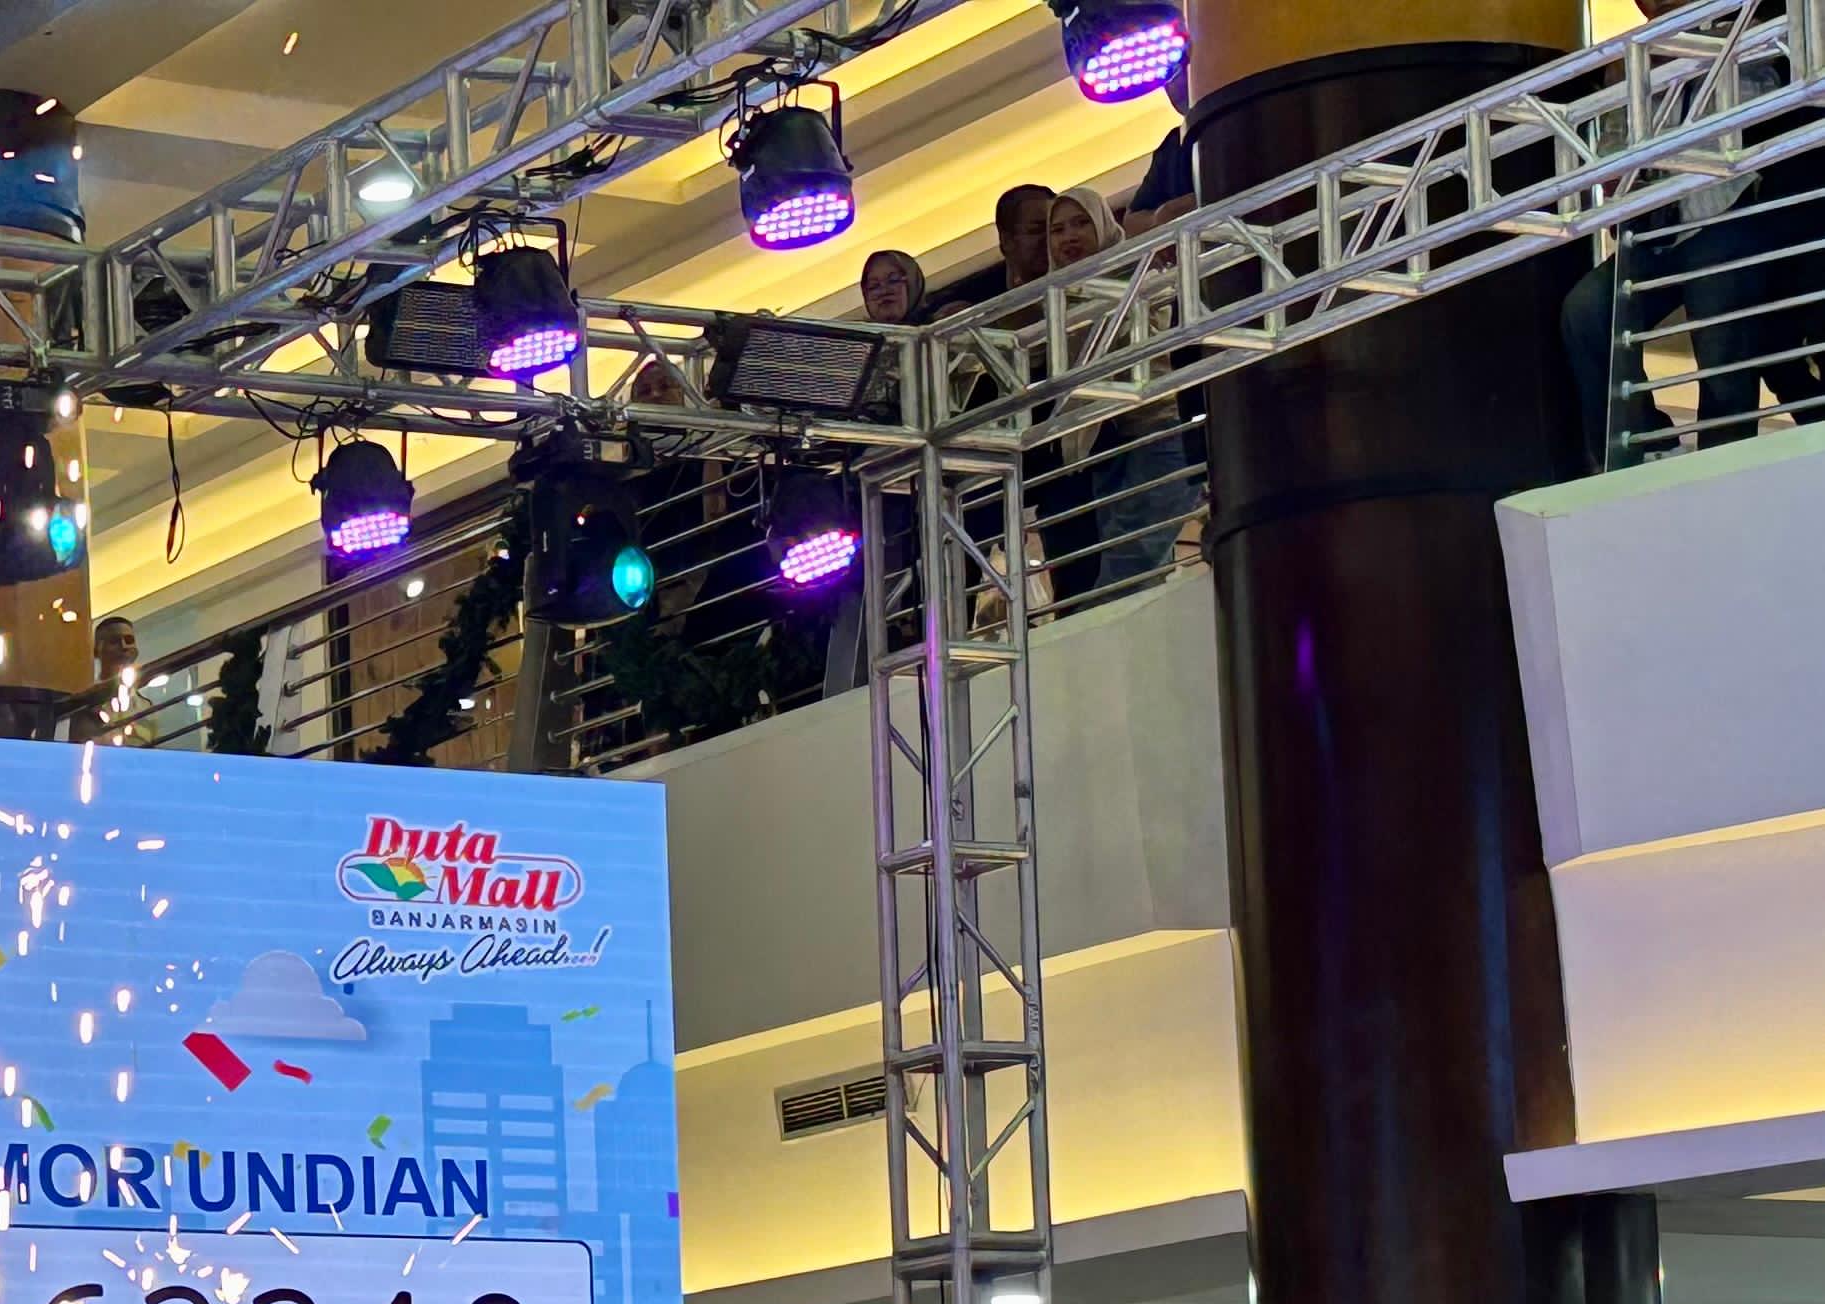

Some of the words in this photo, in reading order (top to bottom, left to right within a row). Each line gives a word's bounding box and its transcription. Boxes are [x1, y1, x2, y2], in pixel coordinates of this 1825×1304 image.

[365, 816, 497, 865] Duta
[435, 865, 562, 912] Mall
[371, 909, 558, 934] BANJARMASIN
[334, 939, 455, 981] Always
[188, 1149, 487, 1220] UNDIAN
